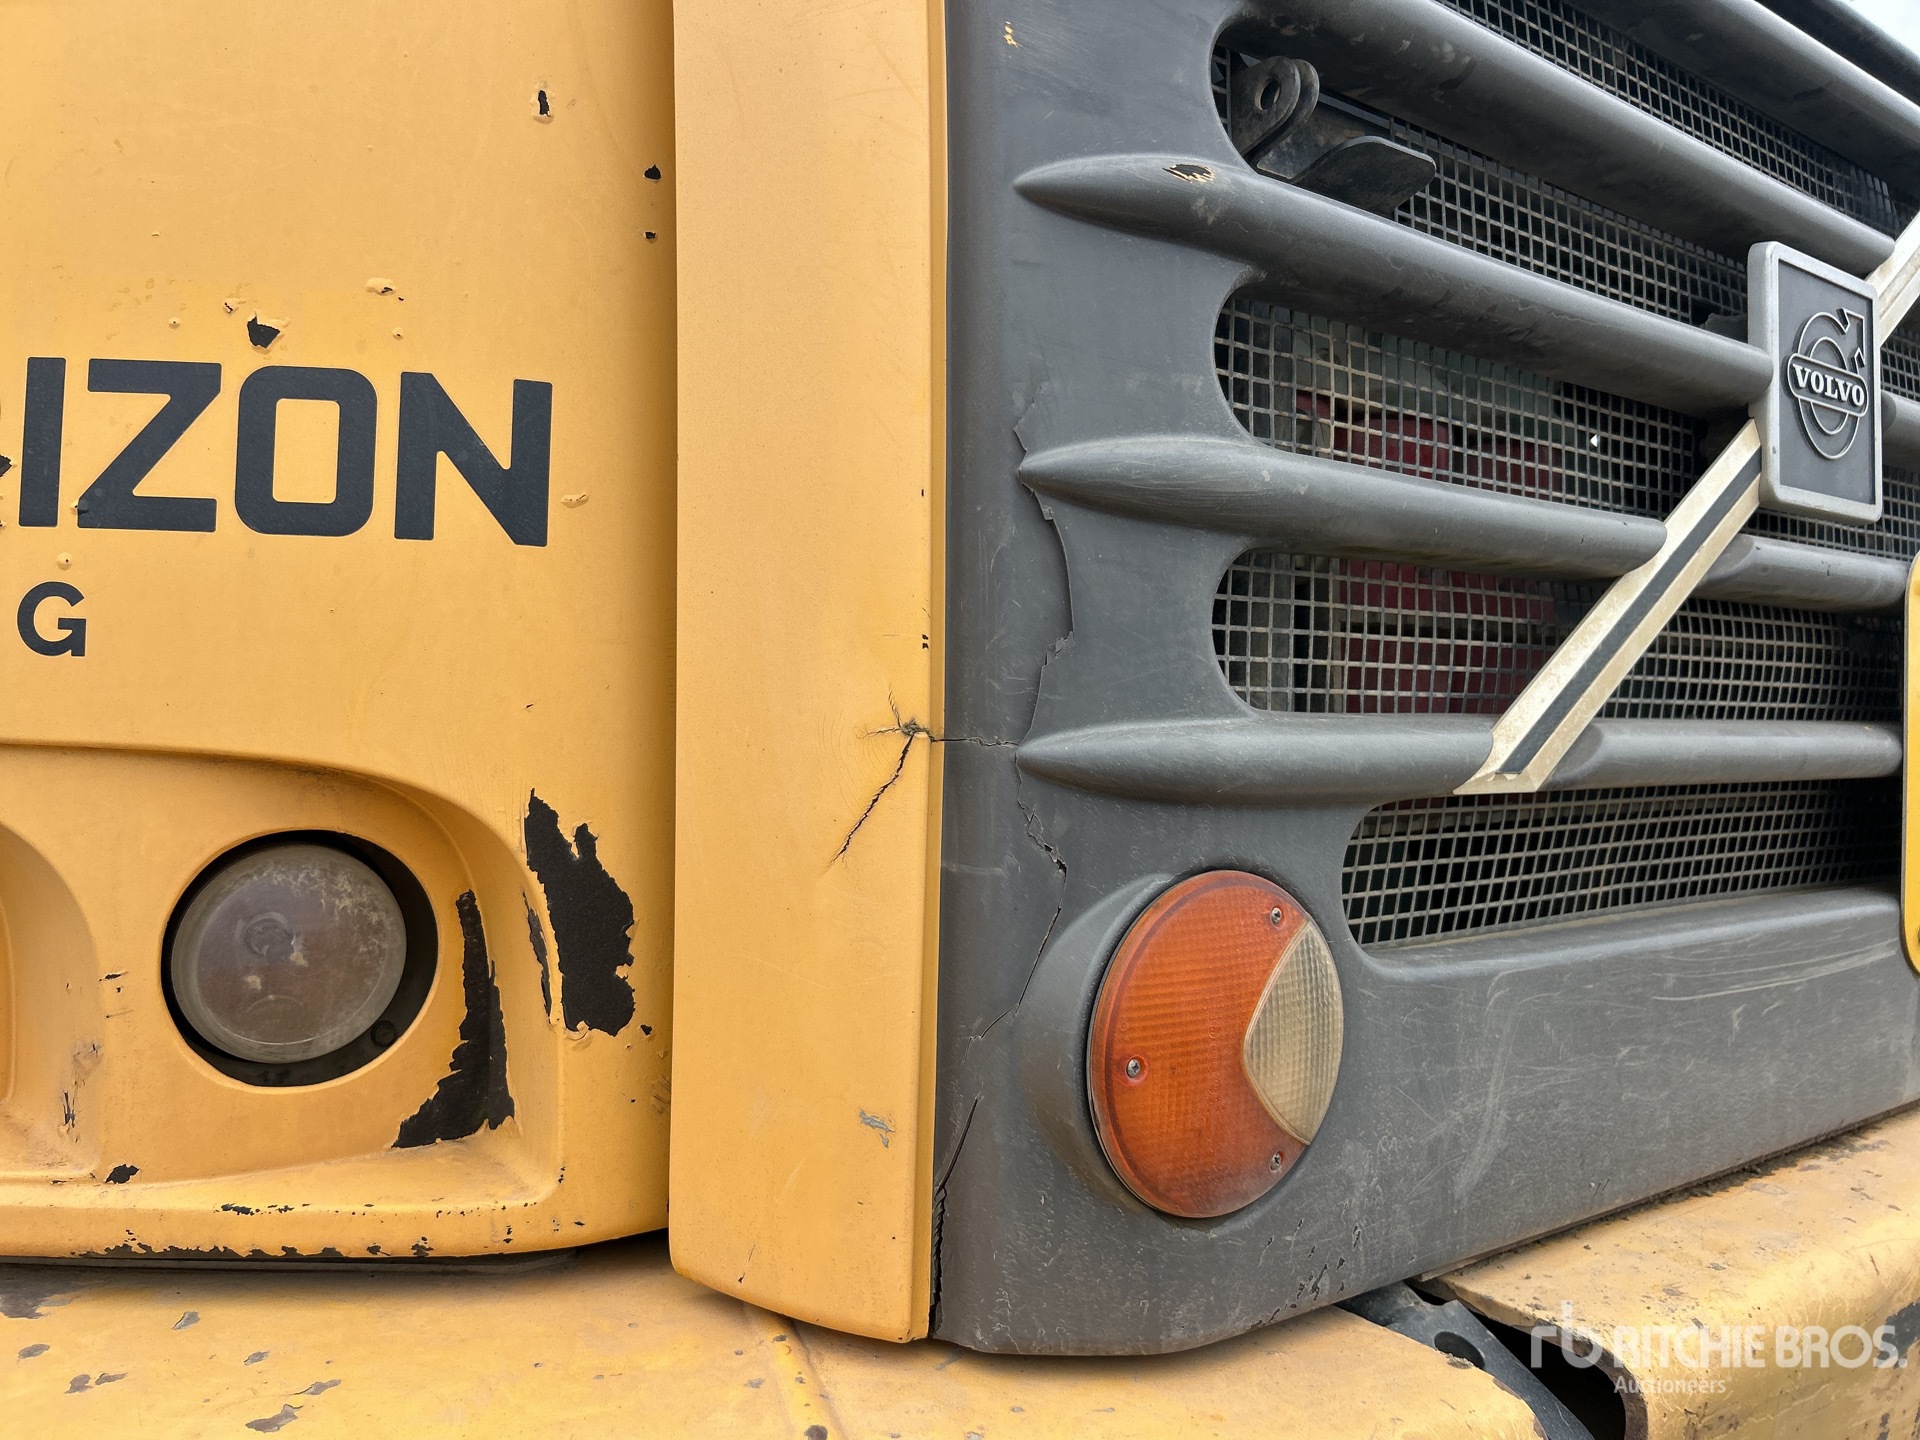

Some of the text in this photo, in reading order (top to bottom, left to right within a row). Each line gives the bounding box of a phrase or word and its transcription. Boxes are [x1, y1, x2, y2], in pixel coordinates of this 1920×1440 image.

[1793, 364, 1865, 407] VOLVO
[0, 357, 553, 547] IZON
[17, 581, 87, 657] G
